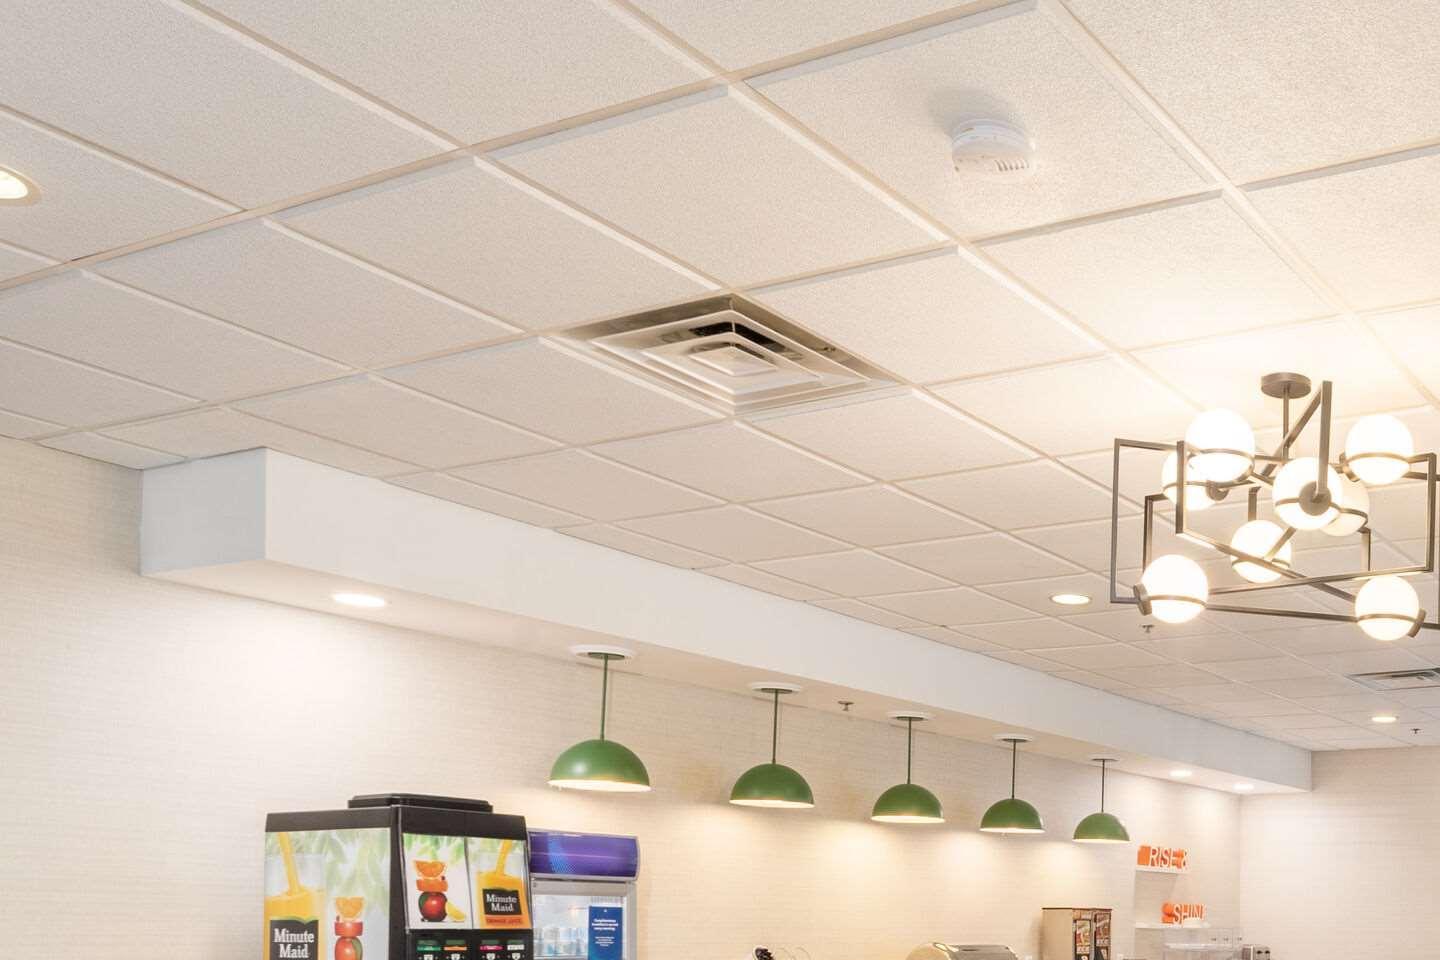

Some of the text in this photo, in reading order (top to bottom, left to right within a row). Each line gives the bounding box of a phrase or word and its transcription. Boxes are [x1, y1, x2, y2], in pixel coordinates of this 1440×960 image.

[1149, 846, 1178, 868] RISE
[485, 893, 518, 903] Minute
[490, 902, 514, 912] Maid
[272, 927, 315, 943] Minute
[278, 943, 310, 959] Maid
